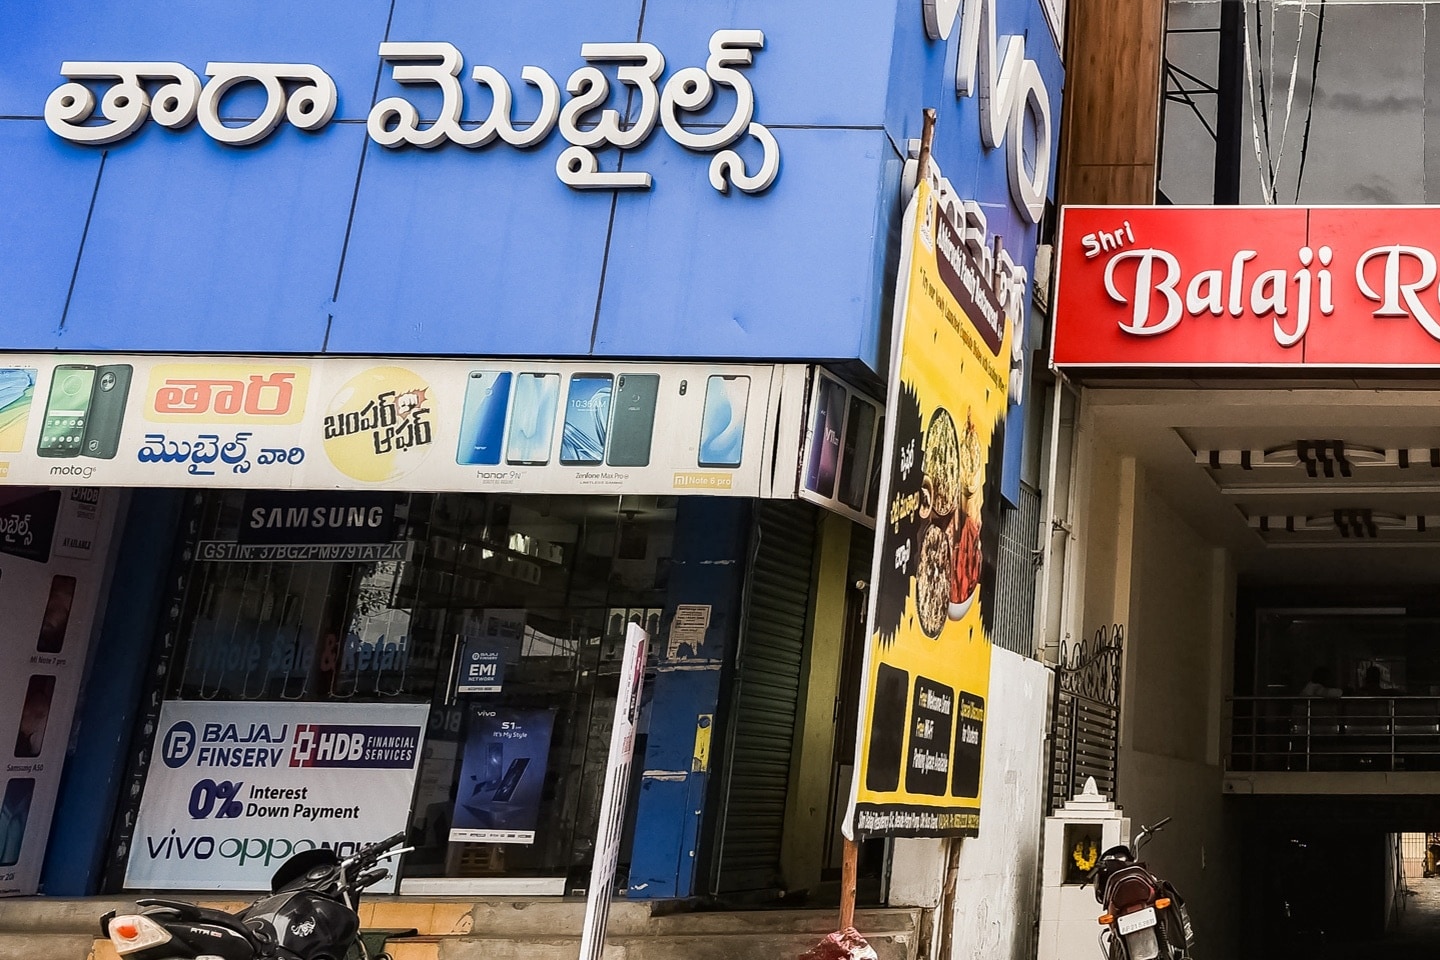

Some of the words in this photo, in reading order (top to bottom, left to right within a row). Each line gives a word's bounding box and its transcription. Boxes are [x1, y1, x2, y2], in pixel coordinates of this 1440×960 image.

[44, 61, 336, 146] తారా
[367, 29, 781, 193] మొబైల్స్
[1082, 220, 1135, 259] Shri
[1103, 244, 1336, 348] Balaji
[154, 372, 296, 416] తార
[323, 390, 397, 440] బంపర్
[137, 432, 253, 476] మొబైల్స్
[257, 445, 305, 466] వారి
[476, 470, 507, 480] honor
[575, 471, 600, 480] Zenfone
[601, 472, 615, 480] Max
[689, 476, 708, 486] Note
[709, 478, 716, 486] 6
[717, 478, 731, 488] pro
[250, 506, 384, 529] SAMSUNG
[204, 543, 255, 560] GSTIN:
[469, 663, 497, 677] EMI
[202, 723, 288, 744] BAJAJ
[501, 721, 516, 730] S1
[196, 746, 284, 770] FINSERV
[316, 733, 365, 762] HDB
[367, 735, 415, 749] FINANCIAL
[364, 748, 413, 762] SERVICES
[7, 764, 32, 773] Samsung
[188, 778, 244, 821] 0%
[249, 784, 309, 801] Interest
[246, 803, 291, 819] Down
[293, 804, 360, 822] Payment
[146, 828, 216, 860] vivo
